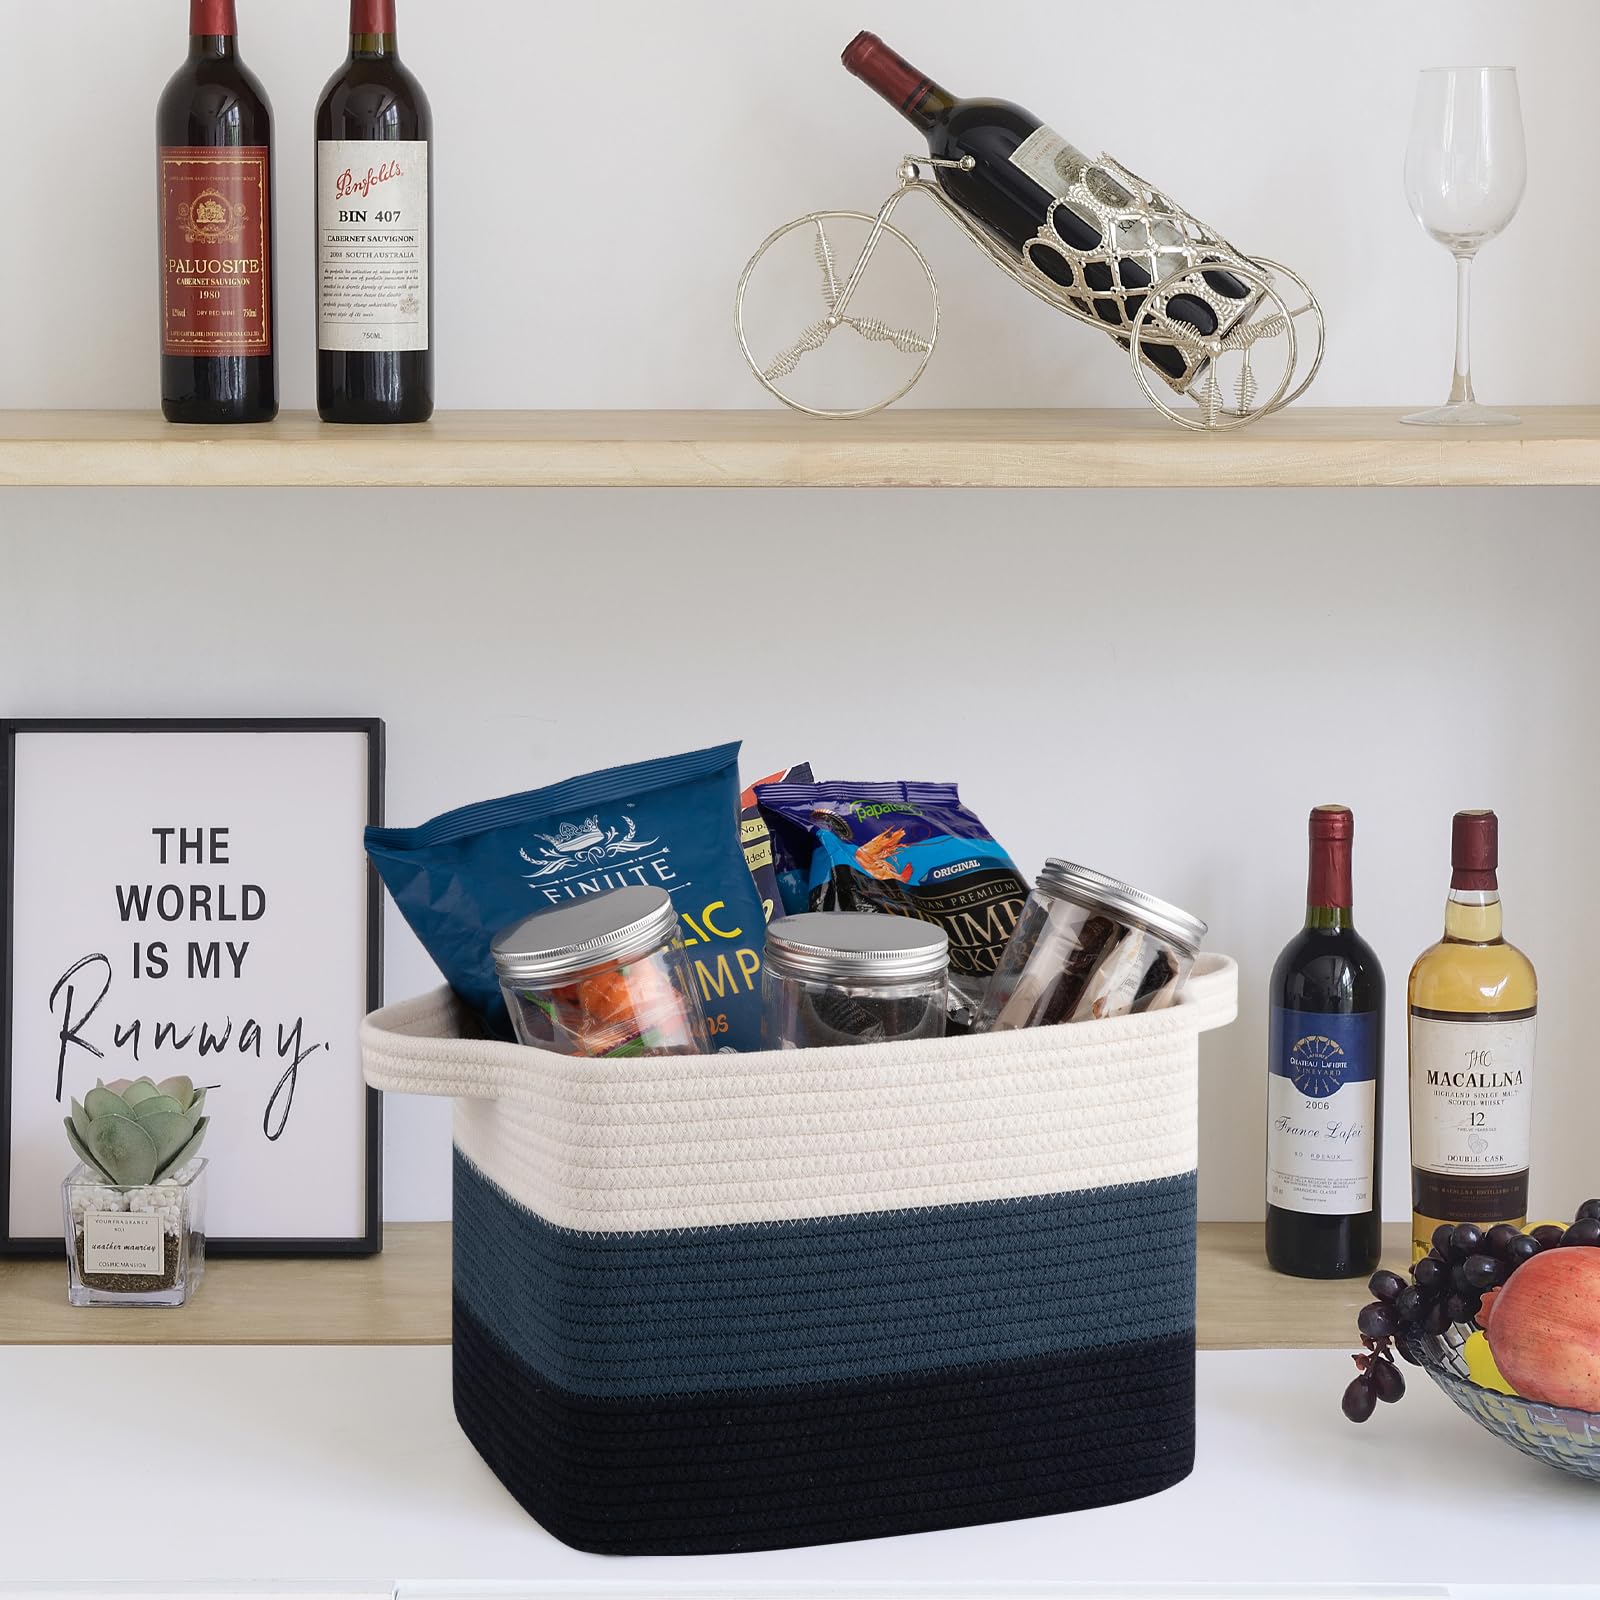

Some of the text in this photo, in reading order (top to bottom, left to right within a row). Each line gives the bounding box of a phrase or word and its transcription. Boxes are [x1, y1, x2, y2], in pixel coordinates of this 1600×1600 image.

[338, 210, 401, 222] BIN 407
[327, 235, 415, 243] CABERNET SAUVIGNON
[169, 258, 260, 274] PALUOSITE
[176, 277, 250, 286] CABERNET SAUVIGNON
[199, 290, 220, 299] 1980
[152, 828, 230, 864] THE
[933, 859, 981, 880] ORIGINAL
[115, 884, 267, 921] WORLD
[950, 882, 1016, 907] PREMIUM
[133, 942, 250, 979] IS MY
[49, 953, 330, 1140] Runway.
[1295, 1067, 1341, 1076] VINEYARD
[1426, 1069, 1523, 1088] MACALLNA
[1305, 1100, 1330, 1110] 2006
[1448, 1098, 1476, 1106] SCOTCH
[1470, 1112, 1486, 1127] 12
[1274, 1115, 1363, 1145] France Lafei
